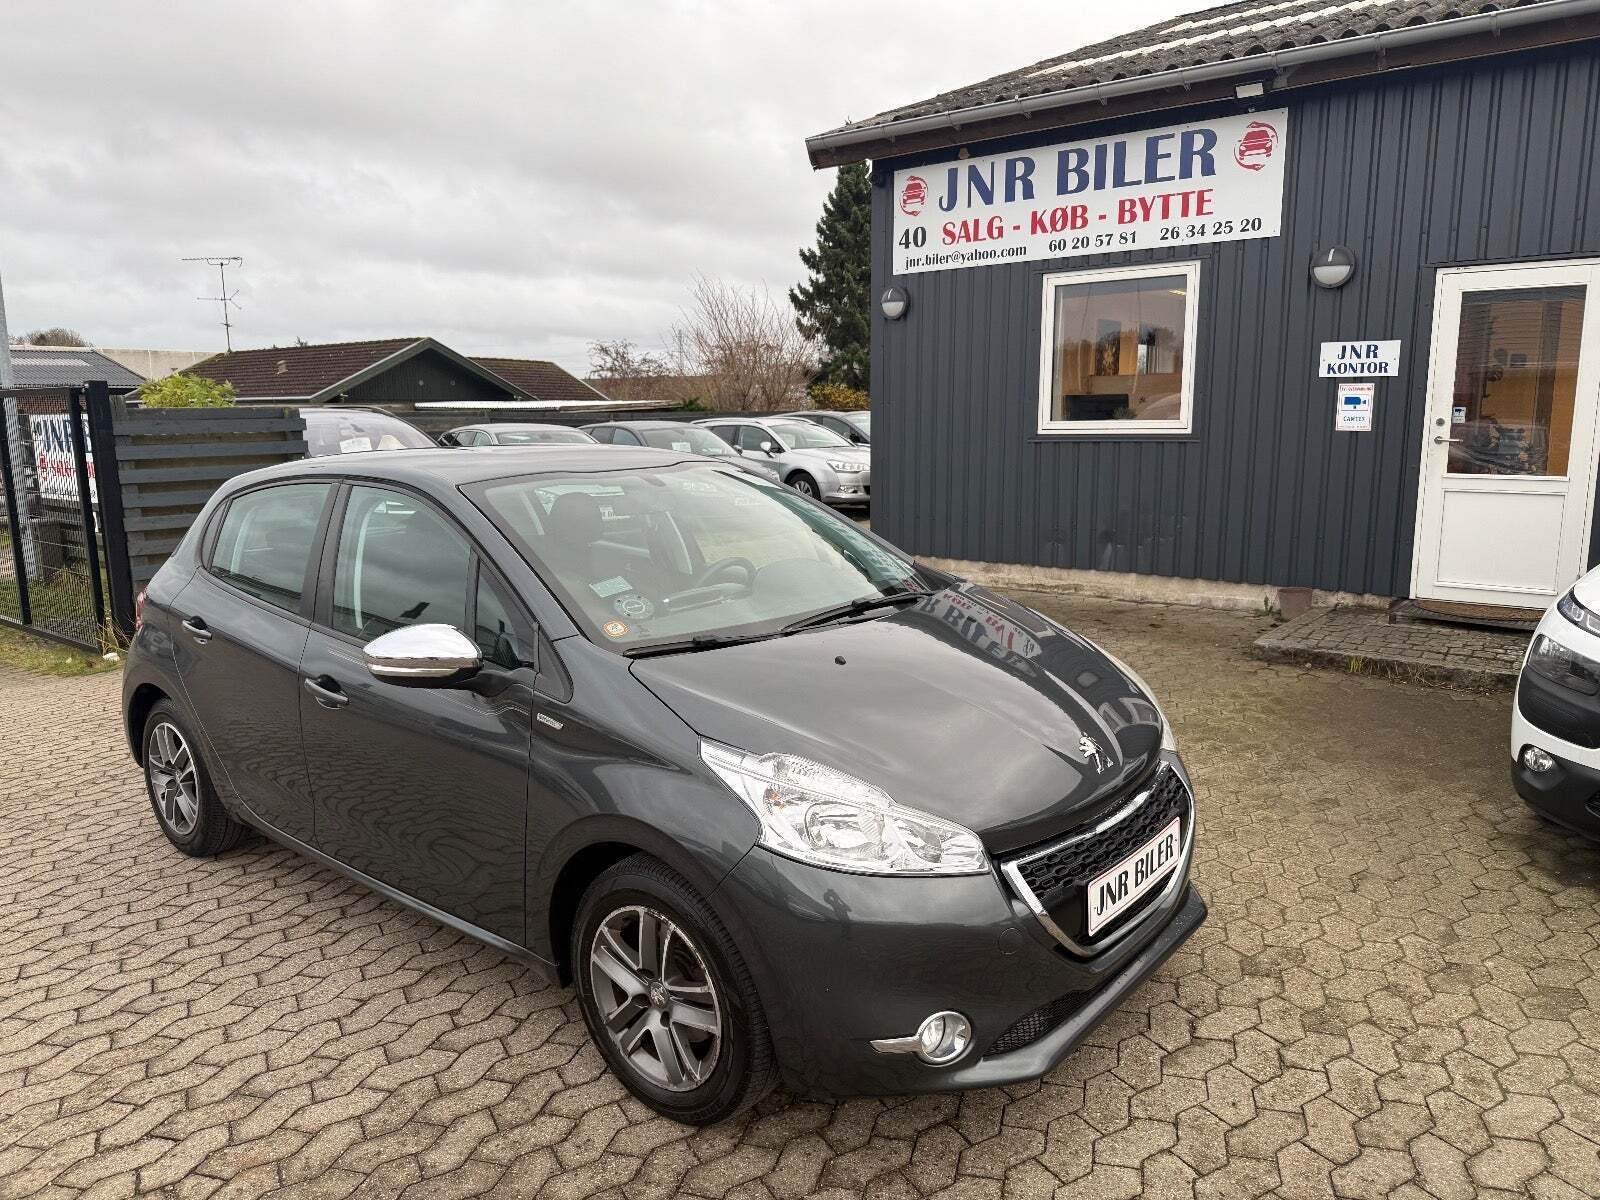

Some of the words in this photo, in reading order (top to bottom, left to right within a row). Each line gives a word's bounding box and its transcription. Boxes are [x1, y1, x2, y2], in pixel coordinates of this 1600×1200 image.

[938, 156, 1036, 212] JNR
[1056, 128, 1217, 196] BILER
[942, 215, 1004, 246] SALG
[1030, 204, 1089, 235] KØB
[1117, 188, 1214, 225] BYTTE
[1159, 225, 1181, 241] 26
[1185, 223, 1206, 238] 34
[1212, 220, 1234, 236] 25
[1239, 217, 1262, 233] 20
[898, 226, 927, 249] 40
[1048, 238, 1067, 253] 60
[1071, 236, 1090, 250] 20
[1094, 233, 1114, 247] 57
[1118, 230, 1137, 245] 81
[905, 245, 1027, 270] jnr.biler@yahoo.com
[1337, 344, 1379, 360] JNR
[1327, 361, 1389, 375] KONTOR
[1096, 870, 1129, 916] JNR
[1134, 833, 1174, 888] BILER
